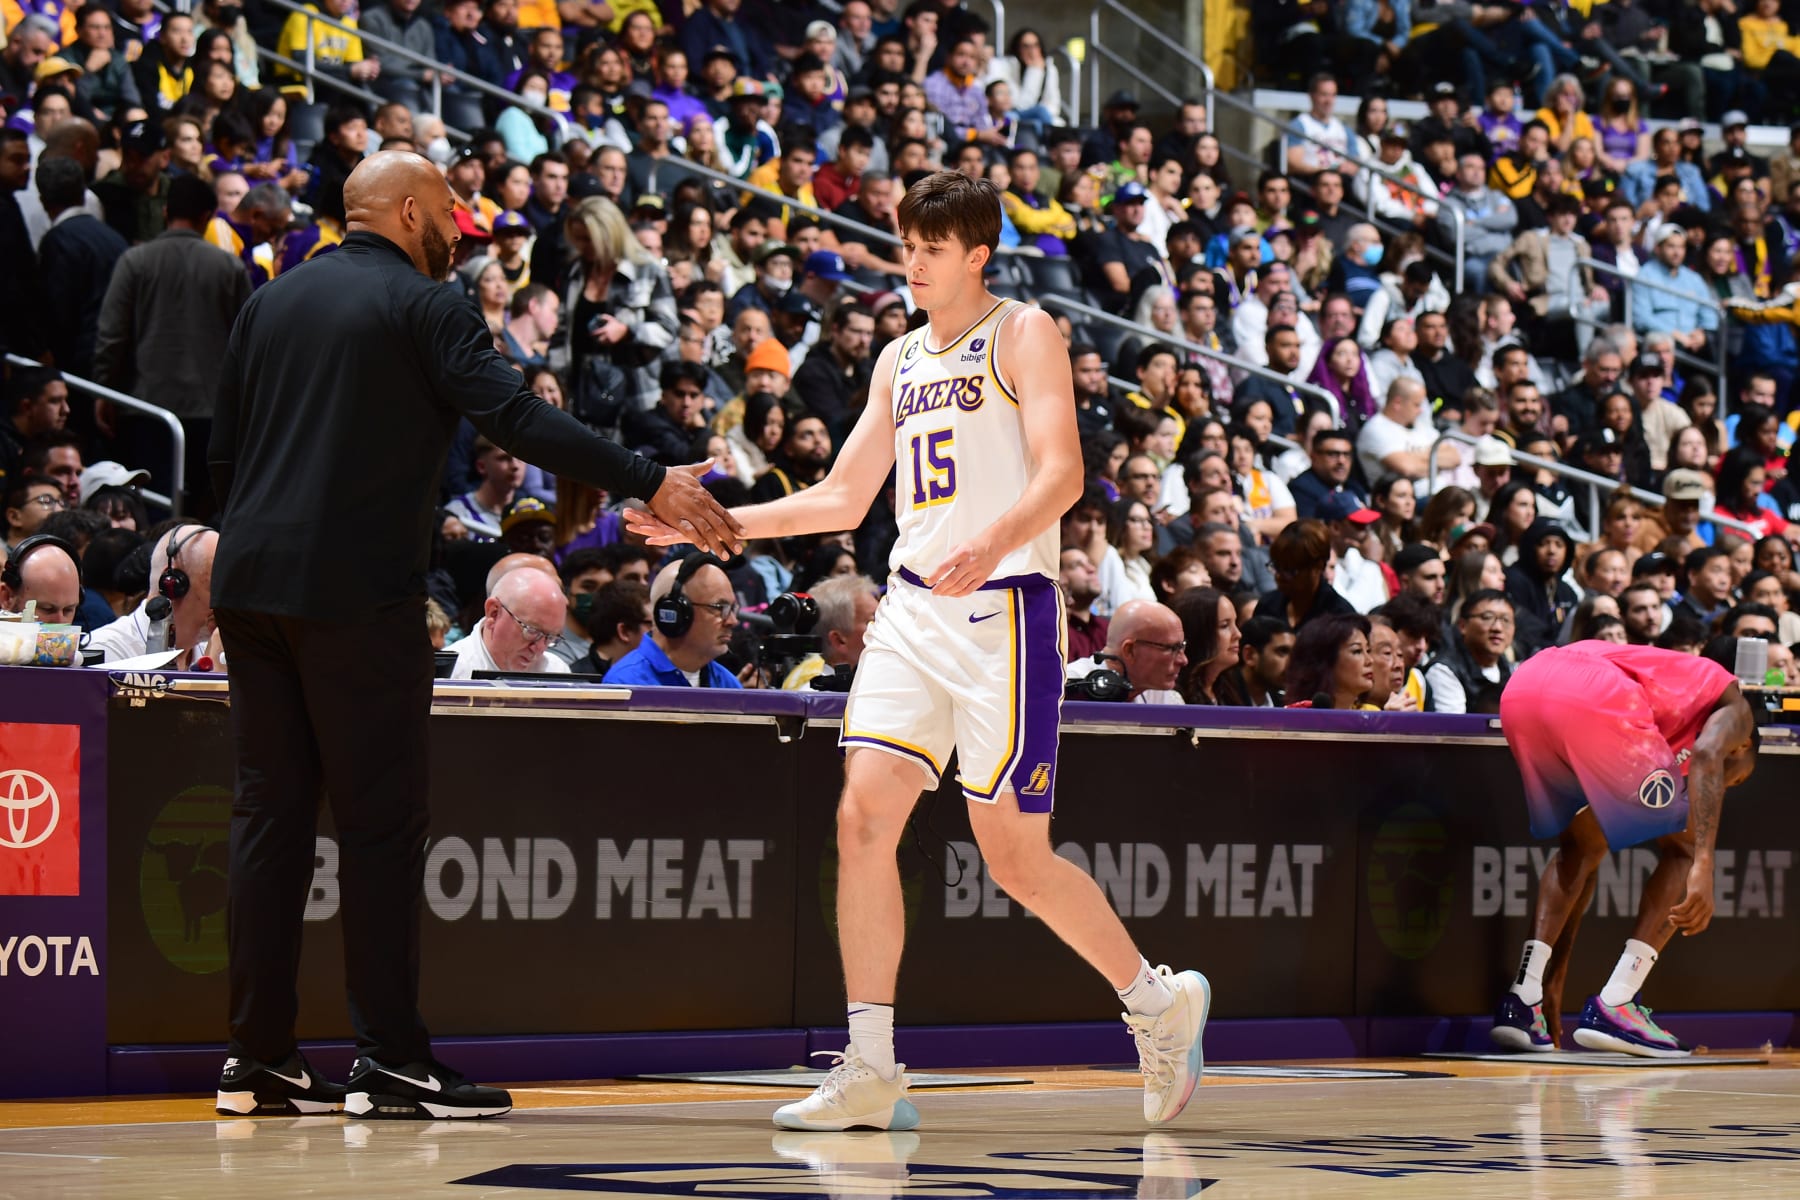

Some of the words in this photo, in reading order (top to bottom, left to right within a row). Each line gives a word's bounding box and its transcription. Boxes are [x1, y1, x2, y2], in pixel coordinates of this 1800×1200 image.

[960, 353, 986, 363] bibigo
[895, 375, 985, 429] LAKERS
[910, 426, 957, 511] 15
[303, 836, 577, 920] BOND
[595, 838, 764, 919] MEAT
[944, 841, 1171, 918] BEND
[1185, 843, 1323, 918] MEAT
[1713, 850, 1791, 917] EAT
